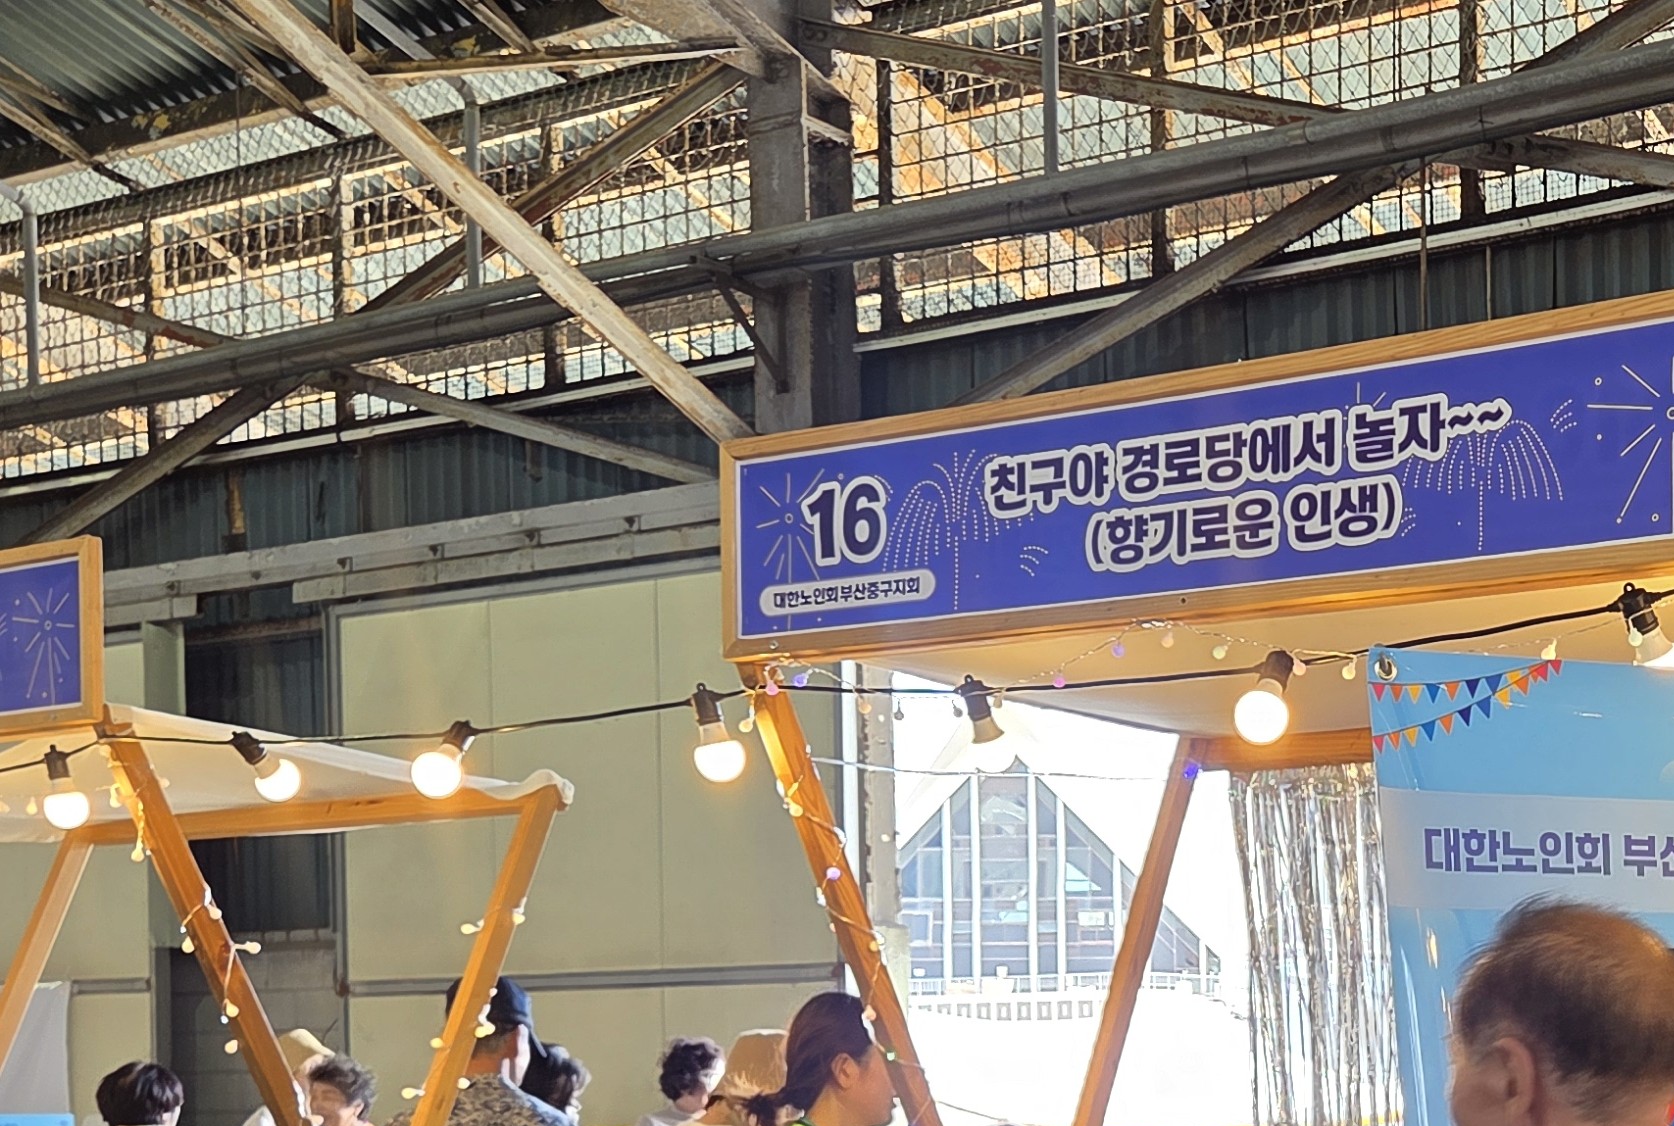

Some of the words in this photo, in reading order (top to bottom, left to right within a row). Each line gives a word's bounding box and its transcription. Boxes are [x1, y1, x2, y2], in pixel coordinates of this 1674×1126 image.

[988, 449, 1110, 513] 친구야
[1120, 415, 1337, 495] 경로당에서
[1352, 401, 1506, 464] 놀자~~
[804, 479, 884, 563] 16
[1090, 496, 1276, 566] (향기로운
[1289, 480, 1397, 544] 인생)
[1423, 826, 1612, 876] 대한노인회
